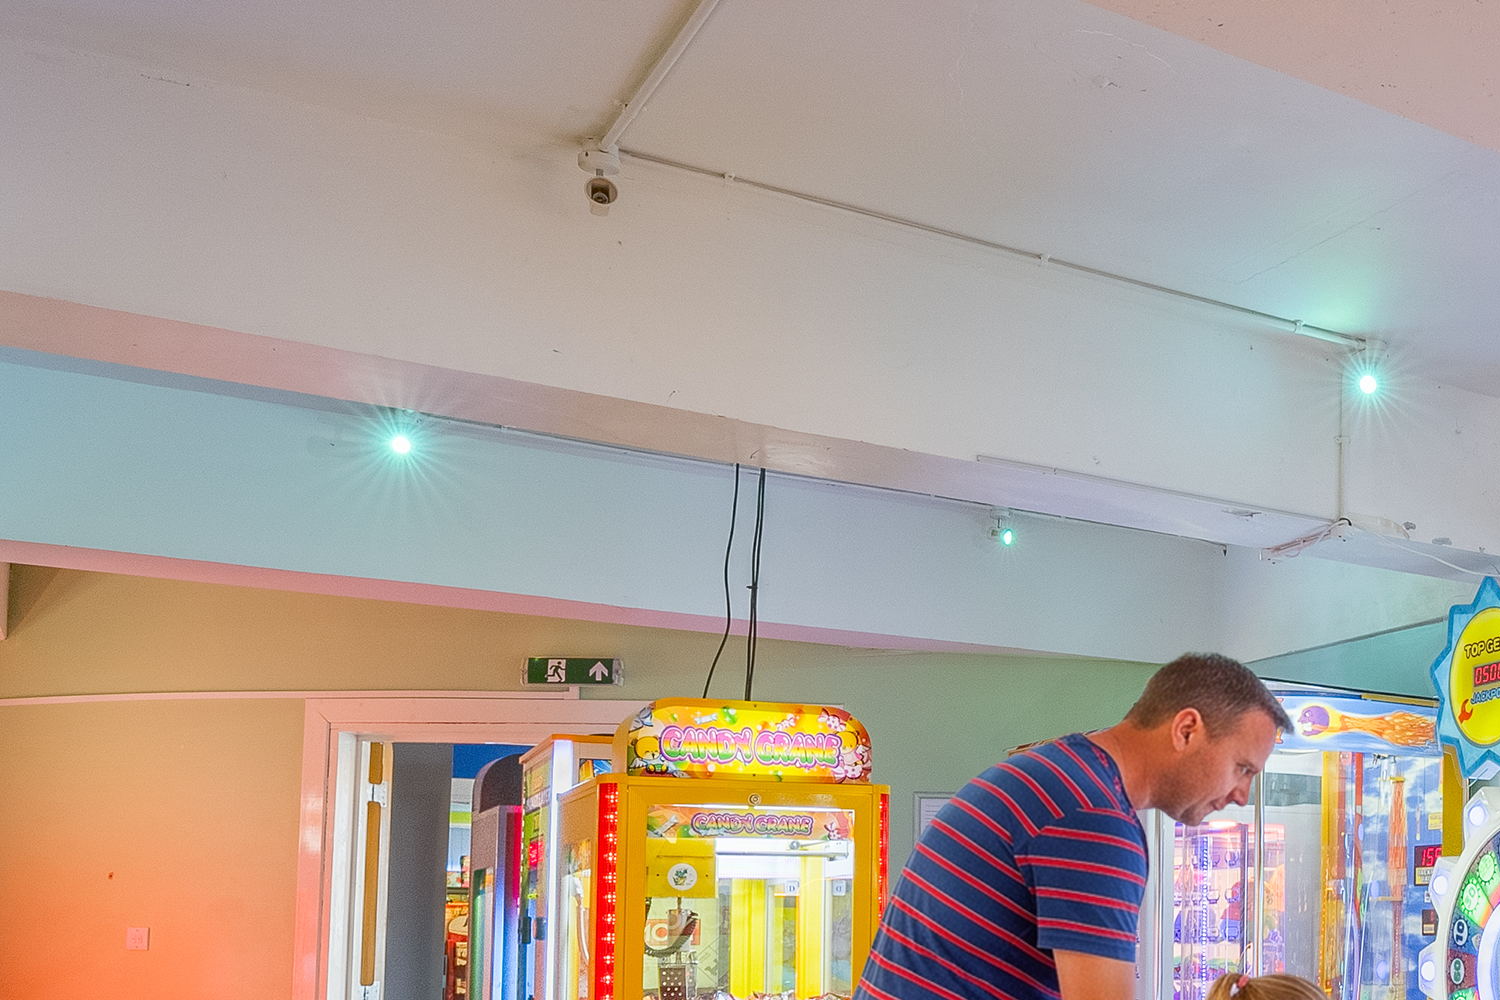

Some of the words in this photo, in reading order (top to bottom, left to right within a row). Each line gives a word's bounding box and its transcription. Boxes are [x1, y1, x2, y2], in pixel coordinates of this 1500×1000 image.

[1464, 641, 1485, 659] TOP
[660, 725, 754, 765] CANDY
[754, 731, 843, 770] CRANE
[691, 813, 754, 836] CANDY
[754, 815, 813, 836] CRANE
